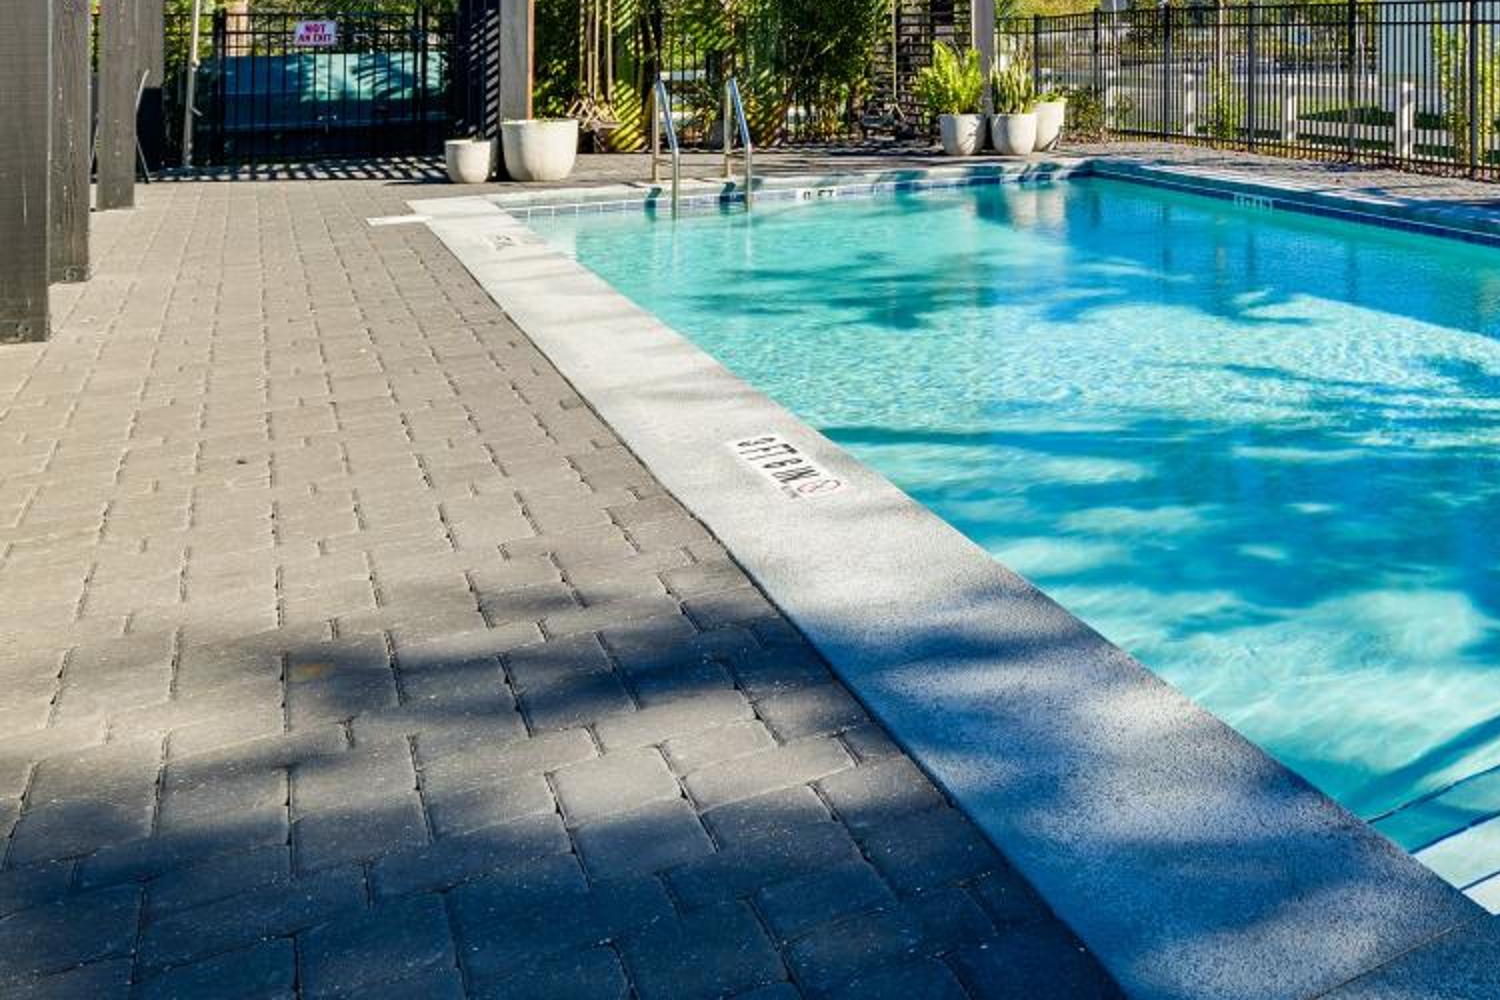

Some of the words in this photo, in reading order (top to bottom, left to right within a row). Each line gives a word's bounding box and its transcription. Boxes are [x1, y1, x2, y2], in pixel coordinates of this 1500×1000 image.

[305, 23, 326, 33] NOT
[738, 443, 798, 460] FT
[771, 465, 821, 483] IN
